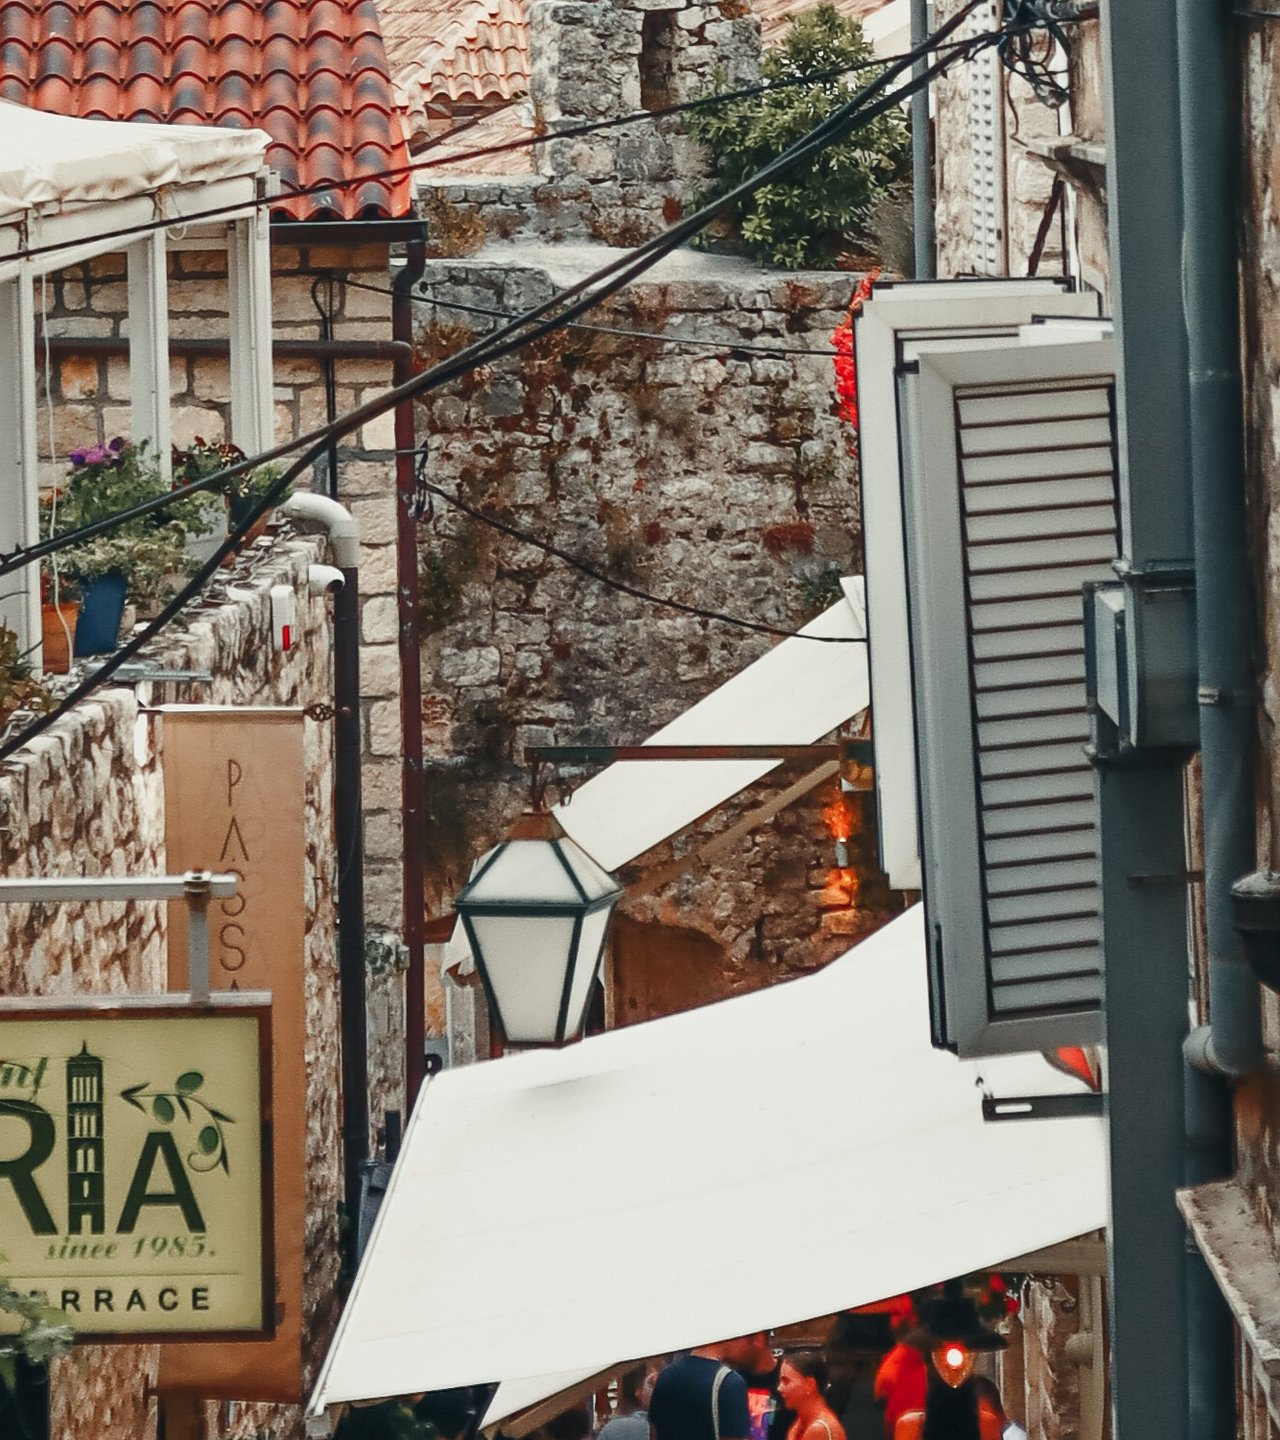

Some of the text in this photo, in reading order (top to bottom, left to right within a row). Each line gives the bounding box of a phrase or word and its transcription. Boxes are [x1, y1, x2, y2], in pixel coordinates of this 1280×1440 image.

[45, 1234, 217, 1261] since 1985.
[6, 1287, 211, 1312] RRACE
